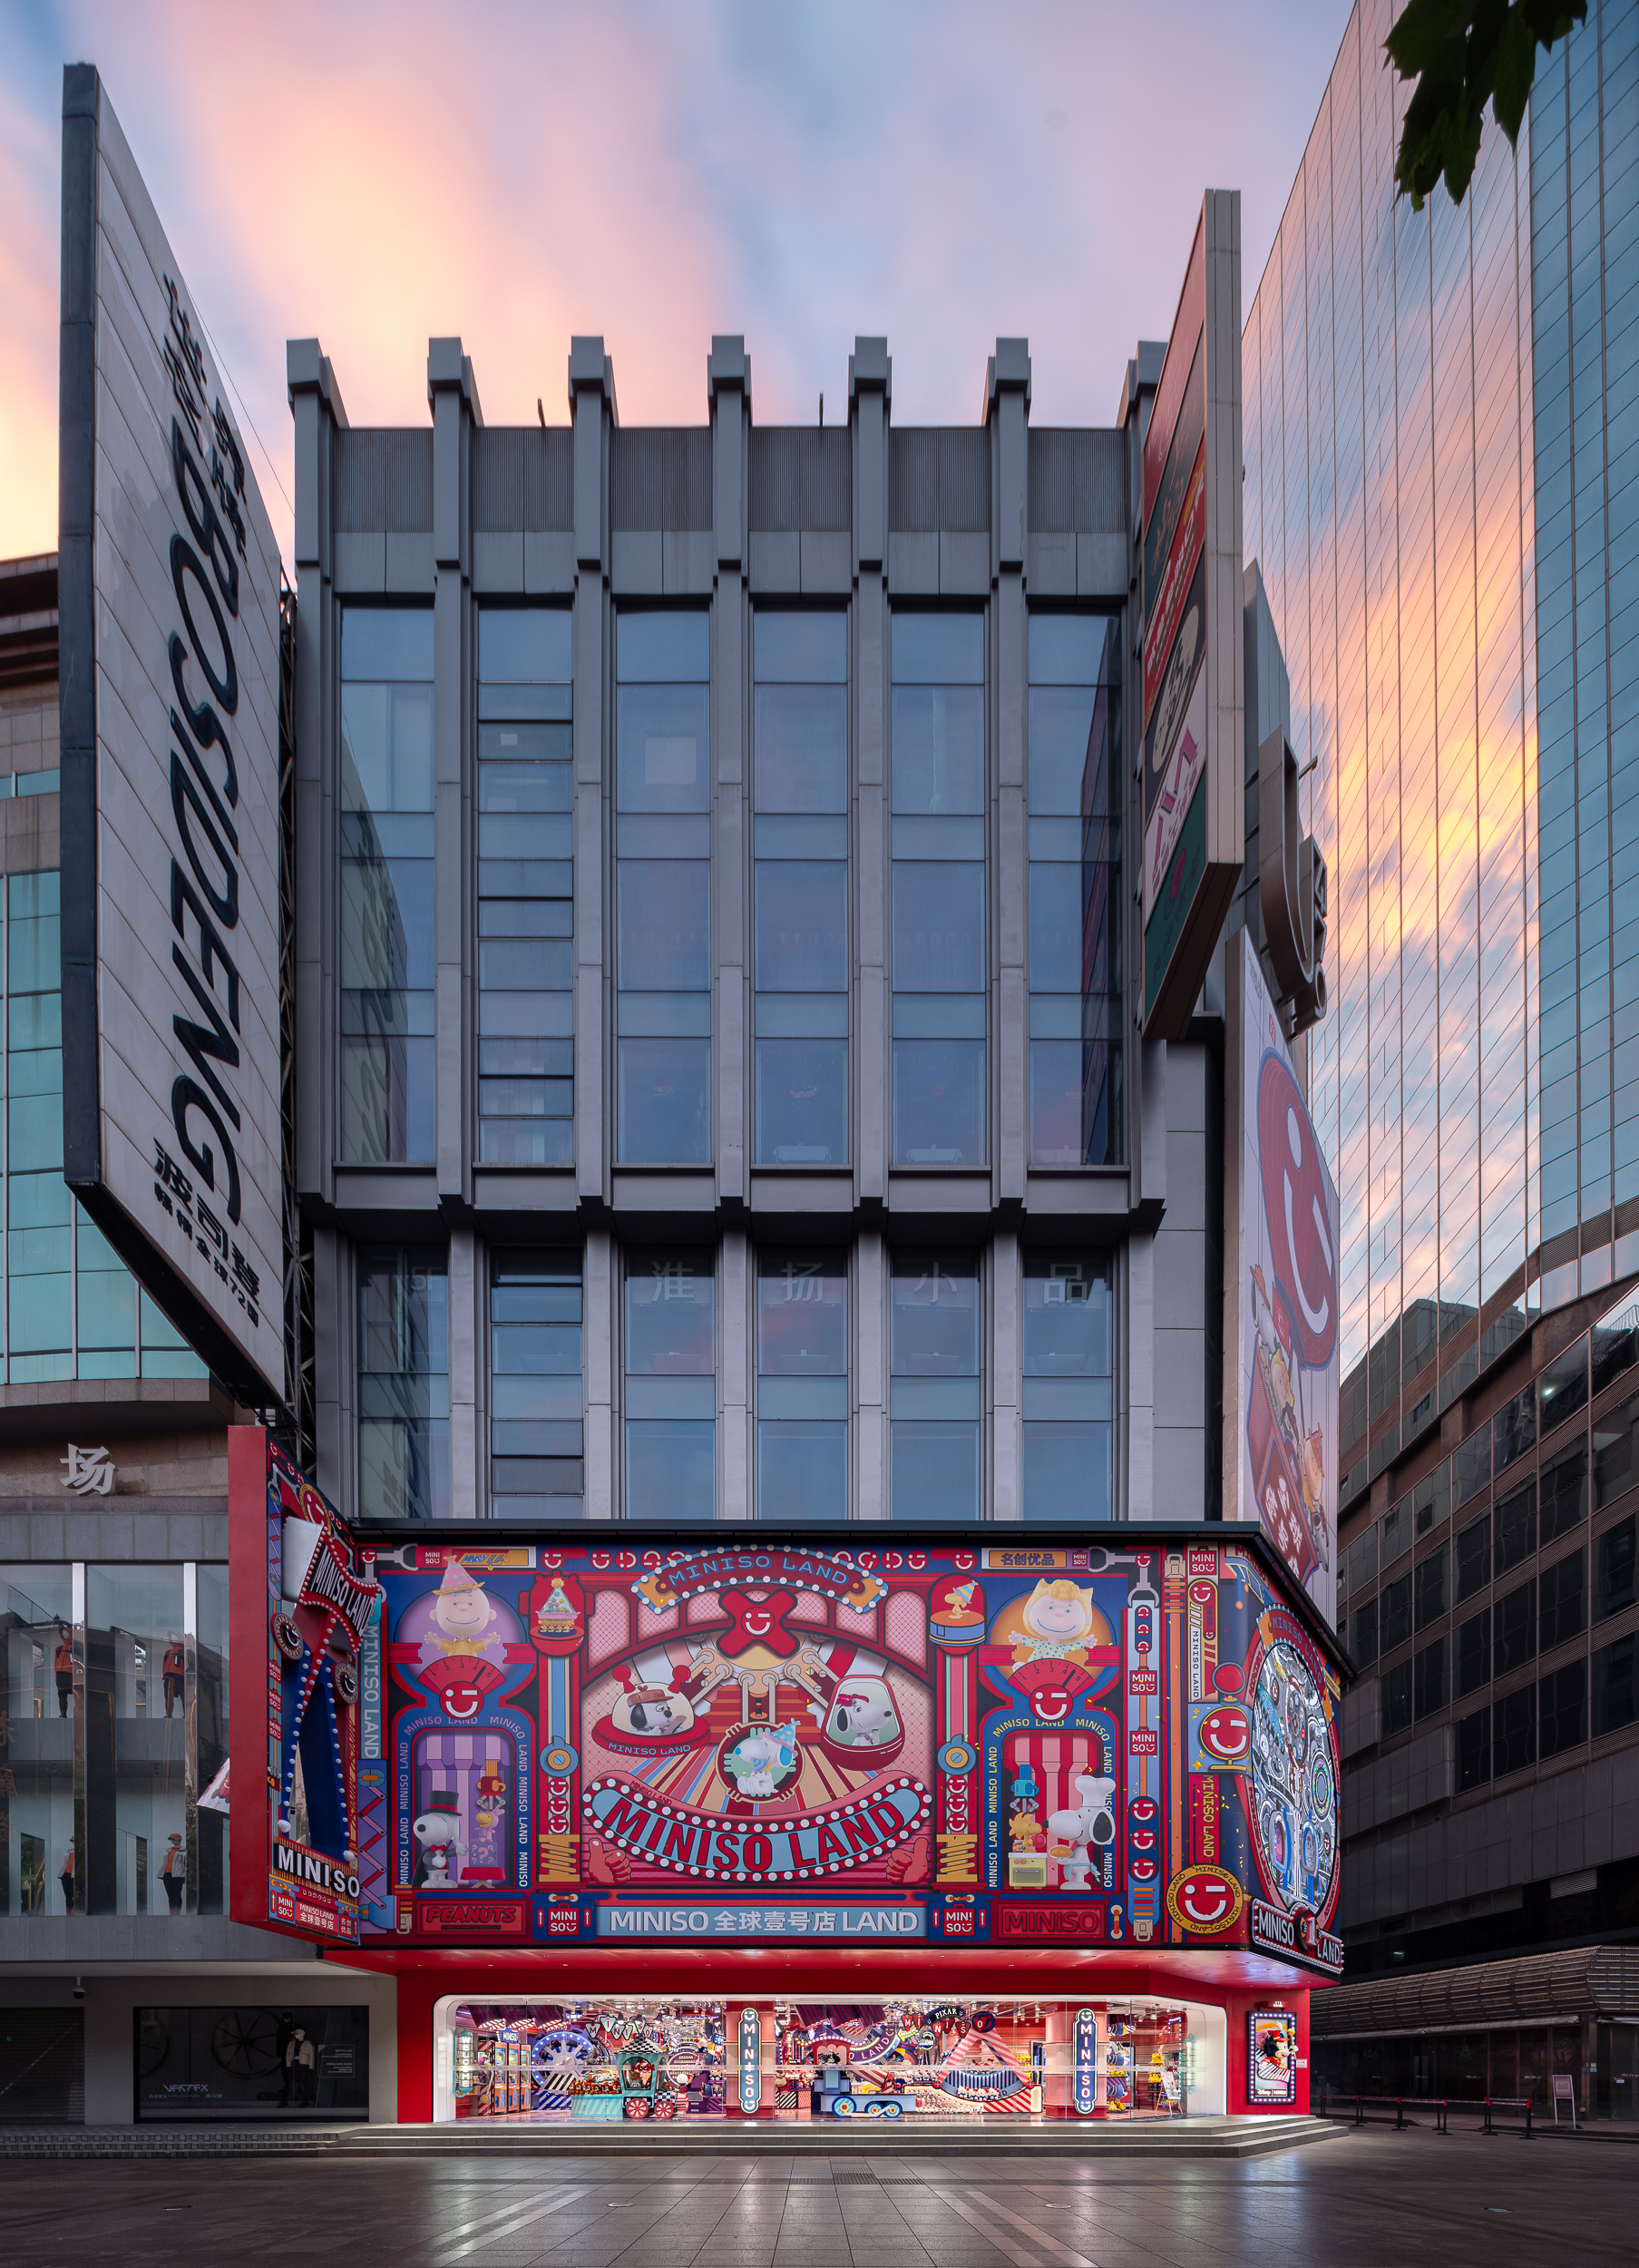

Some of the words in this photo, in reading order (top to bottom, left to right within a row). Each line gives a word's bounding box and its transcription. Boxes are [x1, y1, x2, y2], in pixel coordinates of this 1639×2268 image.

[169, 413, 241, 1226] BOSIDENG
[153, 1137, 259, 1305] 波司登
[60, 1443, 117, 1496] 场
[667, 1555, 772, 1589] MINISO
[782, 1557, 850, 1586] LAND
[1000, 1553, 1054, 1566] 名创优品
[310, 1544, 349, 1607] MINISO
[345, 1588, 375, 1637] LAND
[364, 1626, 379, 1702] MINISO
[1273, 1617, 1302, 1645] MINISO
[1305, 1644, 1322, 1684] LAND
[364, 1709, 379, 1758] LAND
[404, 1716, 442, 1736] MINISO
[490, 1716, 525, 1739] MINISO
[992, 1718, 1029, 1737] MINISO
[1076, 1719, 1110, 1740] MINISO
[400, 1742, 408, 1768] LAND
[519, 1744, 528, 1771] LAND
[609, 1743, 657, 1755] MINISO
[660, 1745, 691, 1755] LAND
[989, 1746, 997, 1773] LAND
[1104, 1746, 1112, 1773] LAND
[400, 1774, 408, 1810] MINISO
[519, 1776, 528, 1812] MINISO
[629, 1780, 652, 1796] MINISO
[653, 1793, 672, 1806] LAND
[989, 1778, 997, 1813] MINISO
[1203, 1775, 1214, 1822] MINISO
[400, 1817, 408, 1844] LAND
[519, 1818, 528, 1844] LAND
[602, 1796, 773, 1872] MINISO
[787, 1799, 905, 1871] LAND
[989, 1821, 997, 1848] LAND
[1203, 1825, 1215, 1857] LAND
[278, 1844, 360, 1898] MINISO
[400, 1849, 408, 1885] MINISO
[519, 1852, 528, 1887] MINISO
[989, 1853, 997, 1887] MINISO
[1104, 1853, 1112, 1887] MINISO
[1170, 1874, 1186, 1892] LAND
[1195, 1867, 1228, 1878] MINISO
[1228, 1877, 1240, 1897] LAND
[278, 1897, 293, 1908] MINI
[300, 1904, 320, 1916] MINISO
[320, 1909, 334, 1920] LAND
[426, 1906, 516, 1923] PEANUTS
[550, 1911, 577, 1921] MINI
[946, 1912, 972, 1921] MINI
[1168, 1892, 1184, 1922] MINISO
[609, 1911, 709, 1932] MINISO
[714, 1910, 837, 1933] 全球壹号店
[843, 1911, 918, 1932] LAND
[1004, 1911, 1103, 1932] MINISO
[1215, 1906, 1239, 1930] MINISO
[1259, 1909, 1294, 1947] MINISO
[1318, 1939, 1340, 1965] LAND
[936, 2008, 957, 2019] PIXAR
[744, 2023, 756, 2097] MINISO
[862, 2037, 889, 2059] LAND
[1080, 2023, 1092, 2098] MINISO
